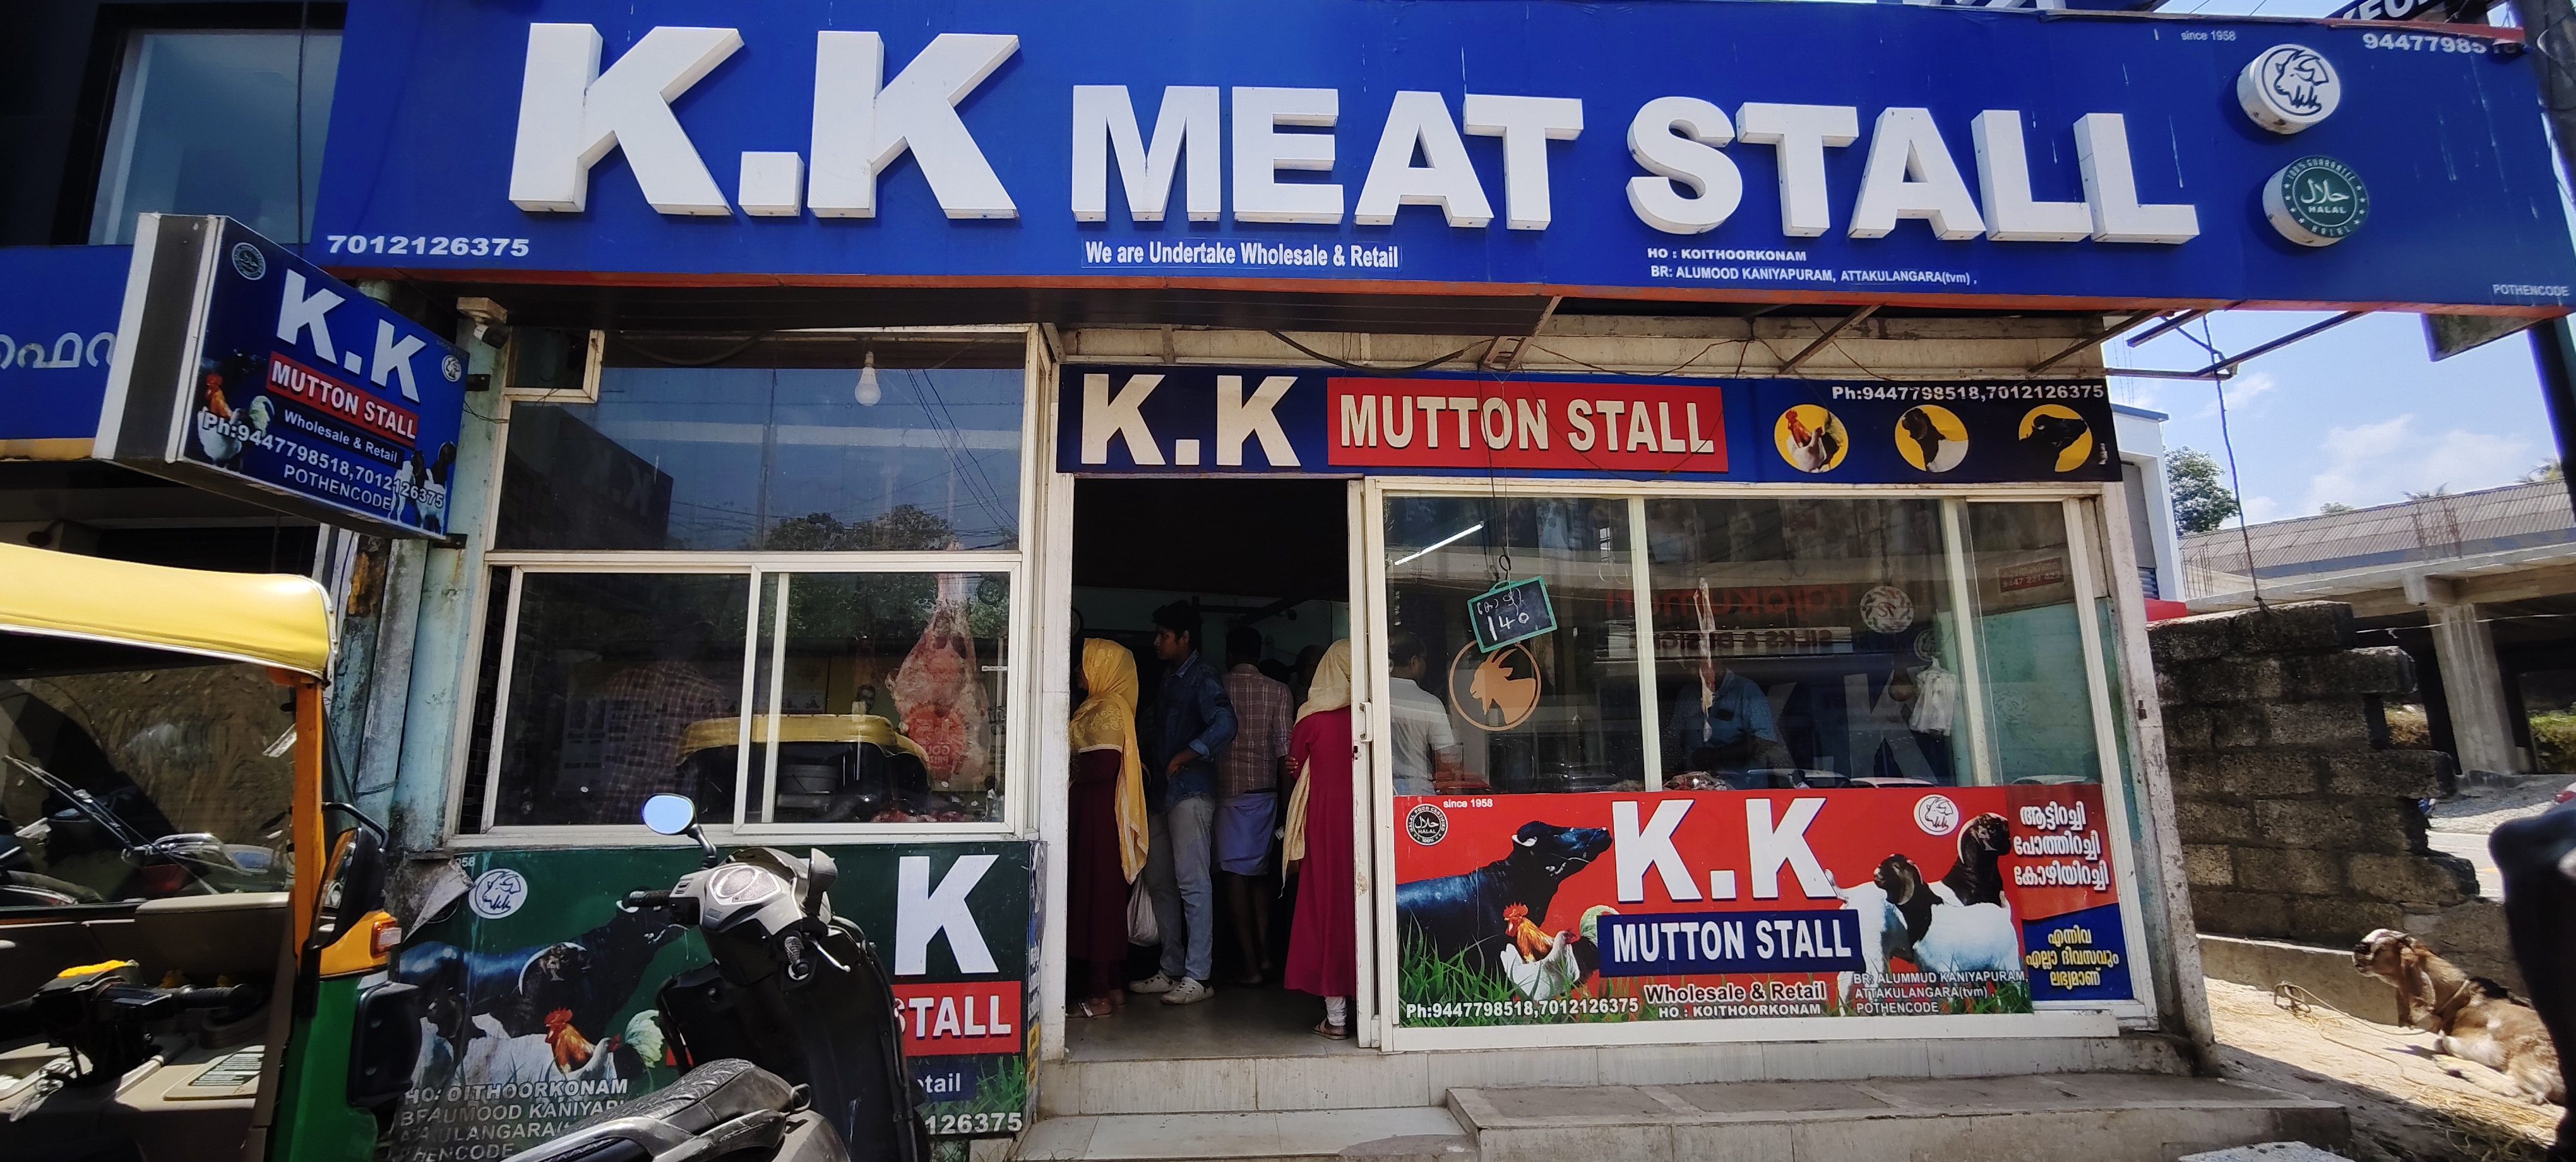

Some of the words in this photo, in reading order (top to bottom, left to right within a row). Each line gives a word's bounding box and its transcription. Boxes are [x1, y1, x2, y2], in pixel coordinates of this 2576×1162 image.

[2181, 30, 2208, 40] since
[2210, 30, 2236, 41] 1958
[509, 22, 1020, 219] K.K
[1071, 84, 1584, 231] MEAT
[1625, 96, 2200, 245] STALL
[2300, 177, 2351, 204] حلال
[2308, 206, 2347, 214] HALAL
[326, 235, 530, 256] 7012126375
[1085, 241, 1113, 263] We
[1117, 246, 1144, 263] are
[1149, 241, 1236, 265] Undertake
[1241, 243, 1328, 266] Wholesale
[1332, 245, 1345, 267] &
[1351, 244, 1399, 268] Retail
[1647, 248, 1668, 258] HO
[1681, 249, 1807, 261] KOITHOORKONAM
[1650, 265, 1673, 278] BR:
[1676, 266, 1739, 280] ALUMOOD
[1742, 268, 1836, 283] KANIYAPURAM,
[1840, 270, 1971, 285] ATTAKULANGARA(tvm)
[2492, 284, 2570, 297] POTHENCODE
[277, 268, 427, 404] K.K
[271, 360, 359, 416] MUTTON
[364, 395, 416, 440] STALL
[1832, 385, 2104, 402] Ph:9447798518,7012126375
[1080, 374, 1301, 467] K.K
[1340, 394, 1549, 452] MUTTON
[1566, 398, 1714, 454] STALL
[284, 409, 350, 445] Wholesale
[353, 436, 363, 450] &
[366, 442, 398, 464] Retail
[202, 412, 444, 508] Ph:9447798518,7012126375
[283, 464, 392, 512] POTHENCODE
[1443, 799, 1467, 808] since
[1470, 798, 1493, 808] 1958
[1414, 806, 1429, 815] FOOD
[1430, 806, 1445, 832] CERTIFIED
[1414, 815, 1439, 829] حلال
[2020, 801, 2086, 830] ആട്ടിറച്ചി
[1612, 798, 1837, 902] K.K
[2013, 830, 2101, 860] പോത്തിറച്ചി
[2013, 860, 2109, 890] കോഴിയിറച്ചി
[1613, 921, 1744, 963] MUTTON
[1756, 919, 1852, 959] STALL
[2048, 925, 2092, 947] എന്നിവ
[2061, 946, 2120, 968] ദിവസവും
[1853, 973, 1874, 984] BR:
[1876, 972, 1937, 984] ALUMMUD
[1940, 971, 2029, 983] KANIYAPURAM,
[1644, 983, 1746, 1003] Wholesale
[1751, 982, 1766, 1001] &
[1770, 981, 1827, 1001] Retail
[1855, 986, 1988, 999] ATTAKULANGARA(tvm)
[1405, 997, 1638, 1019] Ph:9447798518,7012126375
[1659, 1007, 1679, 1018] HO
[1694, 1003, 1821, 1017] KOITHOORKONAM
[1856, 1002, 1939, 1013] POTHENCODE
[917, 1073, 960, 1093] tail
[529, 1099, 624, 1119] KANIYAP
[925, 1113, 1022, 1135] 126375
